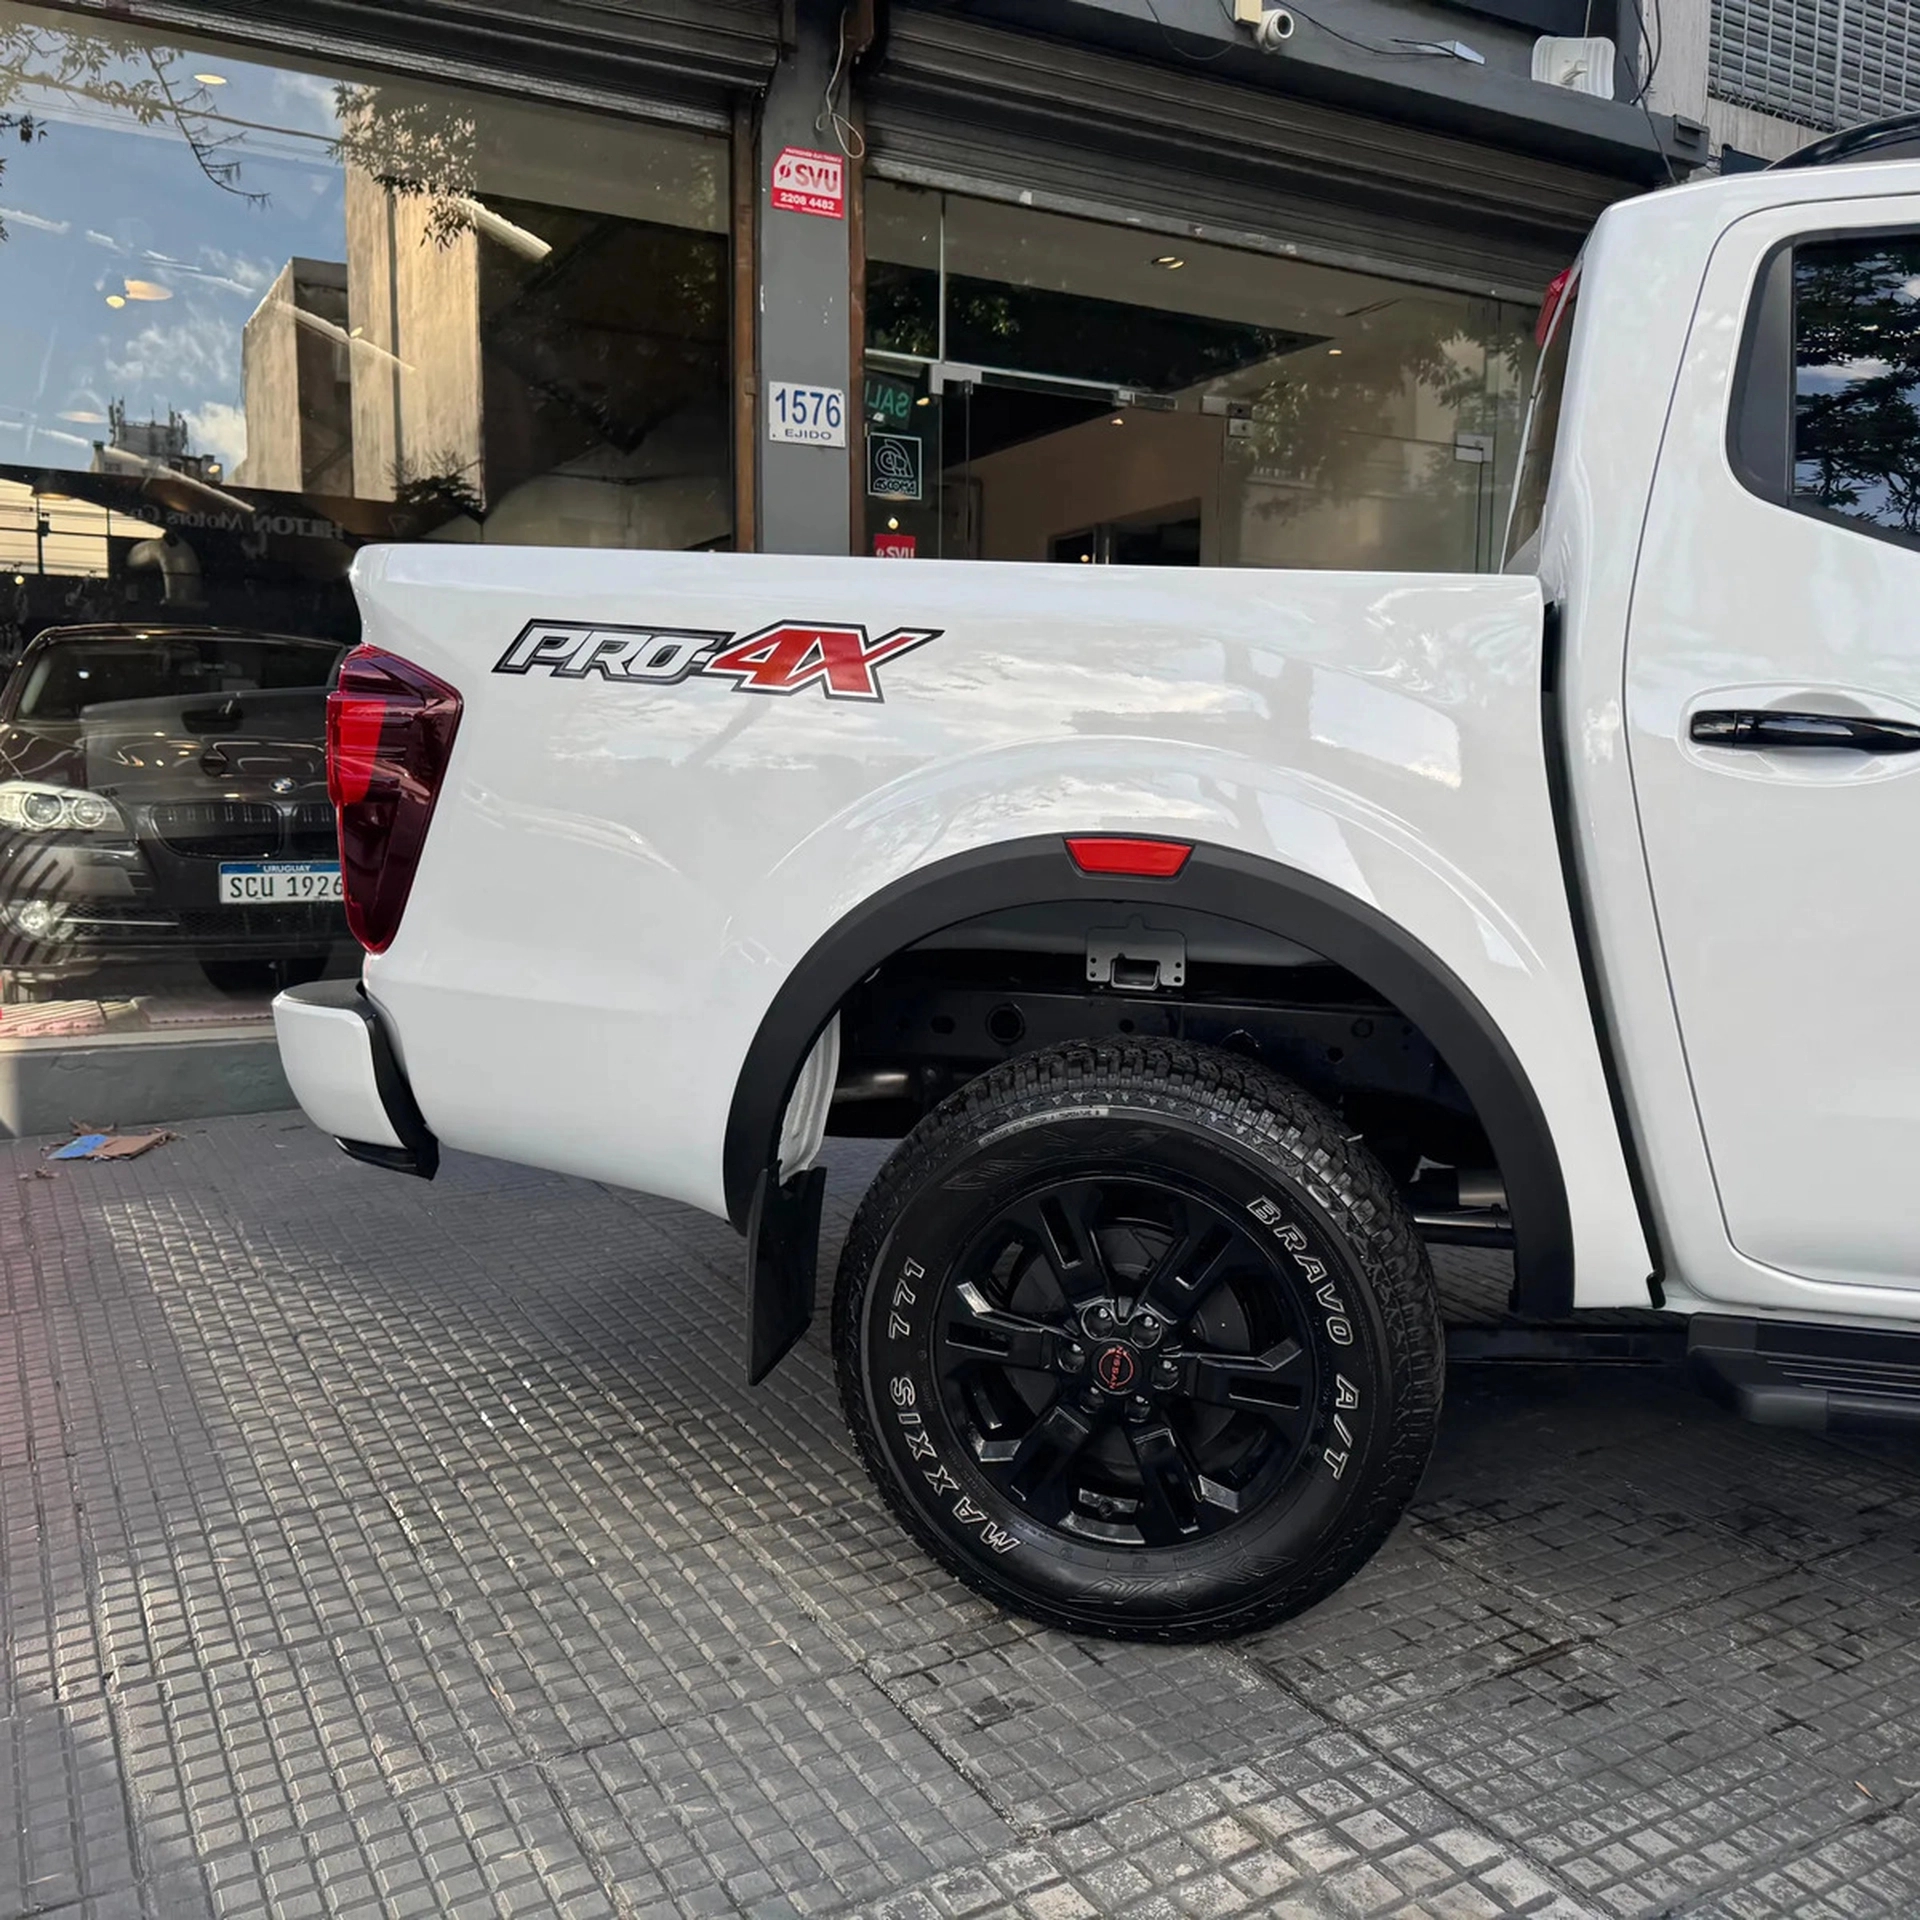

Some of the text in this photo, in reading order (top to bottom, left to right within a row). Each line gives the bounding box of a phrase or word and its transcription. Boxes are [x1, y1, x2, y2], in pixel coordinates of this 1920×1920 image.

[795, 164, 838, 192] SVU
[775, 388, 842, 428] 1576
[785, 428, 832, 440] EJIDO
[491, 618, 945, 703] PRO-4X
[230, 876, 343, 898] SCU 1926
[263, 864, 312, 873] URUGUAY
[888, 1256, 925, 1340] 771
[1246, 1195, 1359, 1480] BRAVO A/T
[890, 1376, 1021, 1554] MAXXIS
